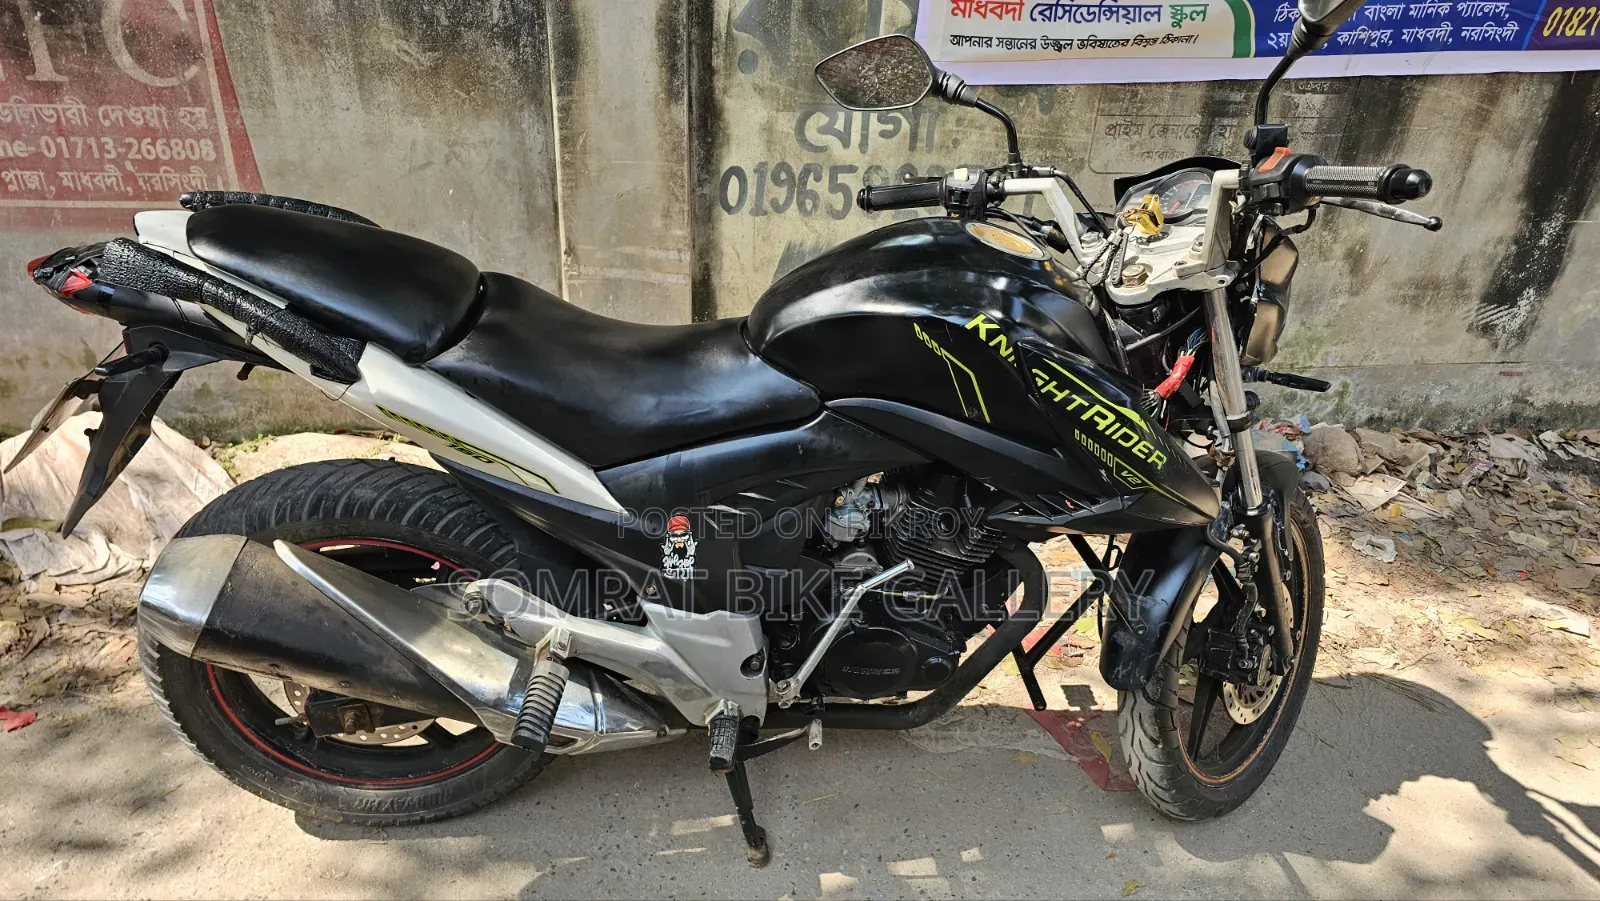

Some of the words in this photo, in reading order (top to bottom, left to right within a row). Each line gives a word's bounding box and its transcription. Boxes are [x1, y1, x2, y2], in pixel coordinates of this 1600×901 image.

[1168, 3, 1209, 29] স্কুল
[1364, 3, 1405, 21] বাংলা
[1408, 0, 1451, 19] মানিক
[950, 34, 993, 48] আপনার
[996, 37, 1037, 50] সন্তানের
[1336, 26, 1393, 48] কাশিপুর,
[1401, 21, 1453, 45] মাধবদী,
[1461, 21, 1519, 42] নরসিংদী
[0, 95, 88, 127] ডলিভারী
[40, 135, 216, 161] 01713-266808
